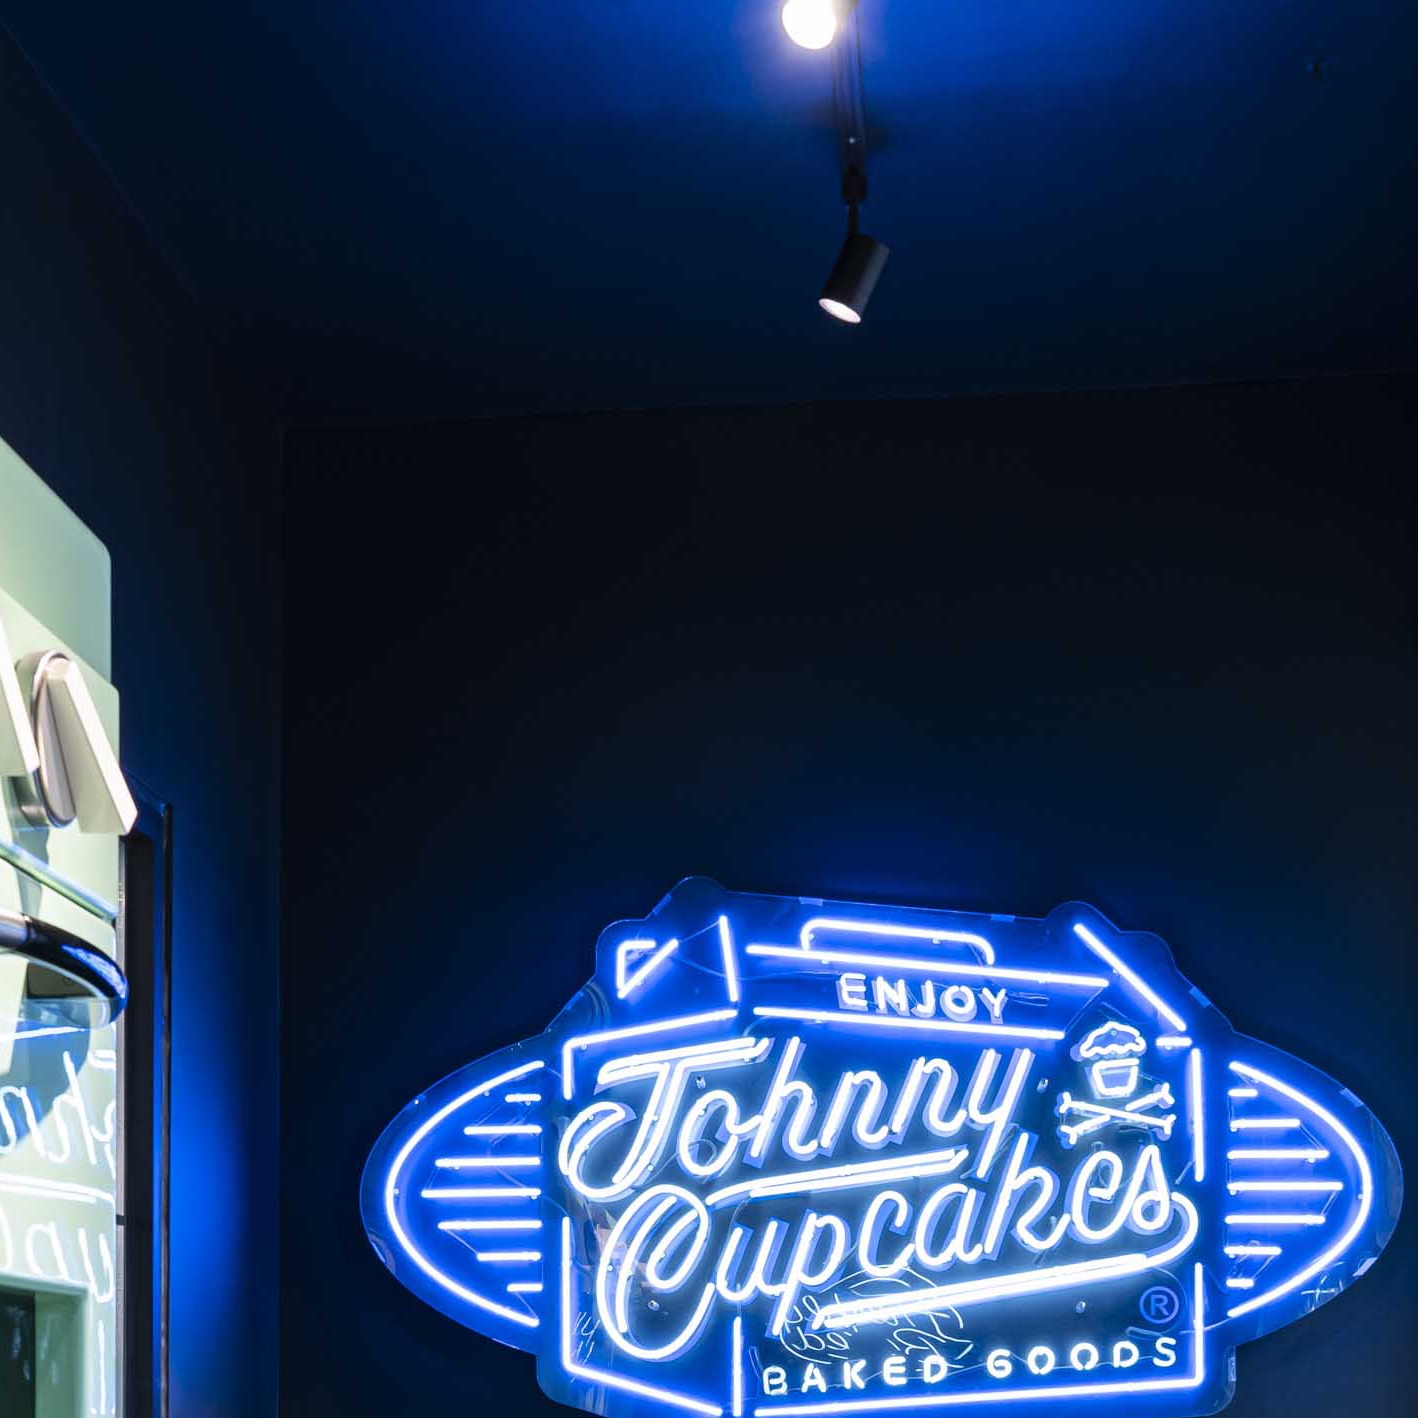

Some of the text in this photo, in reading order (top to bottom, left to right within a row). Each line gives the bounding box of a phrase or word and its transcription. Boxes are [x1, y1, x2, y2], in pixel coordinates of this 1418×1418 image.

[839, 972, 1009, 1024] ENJOY
[557, 1035, 1036, 1202] Johnny
[595, 1132, 1199, 1361] Cupcakes
[762, 1354, 949, 1396] BAKED
[986, 1337, 1177, 1379] GOODS
